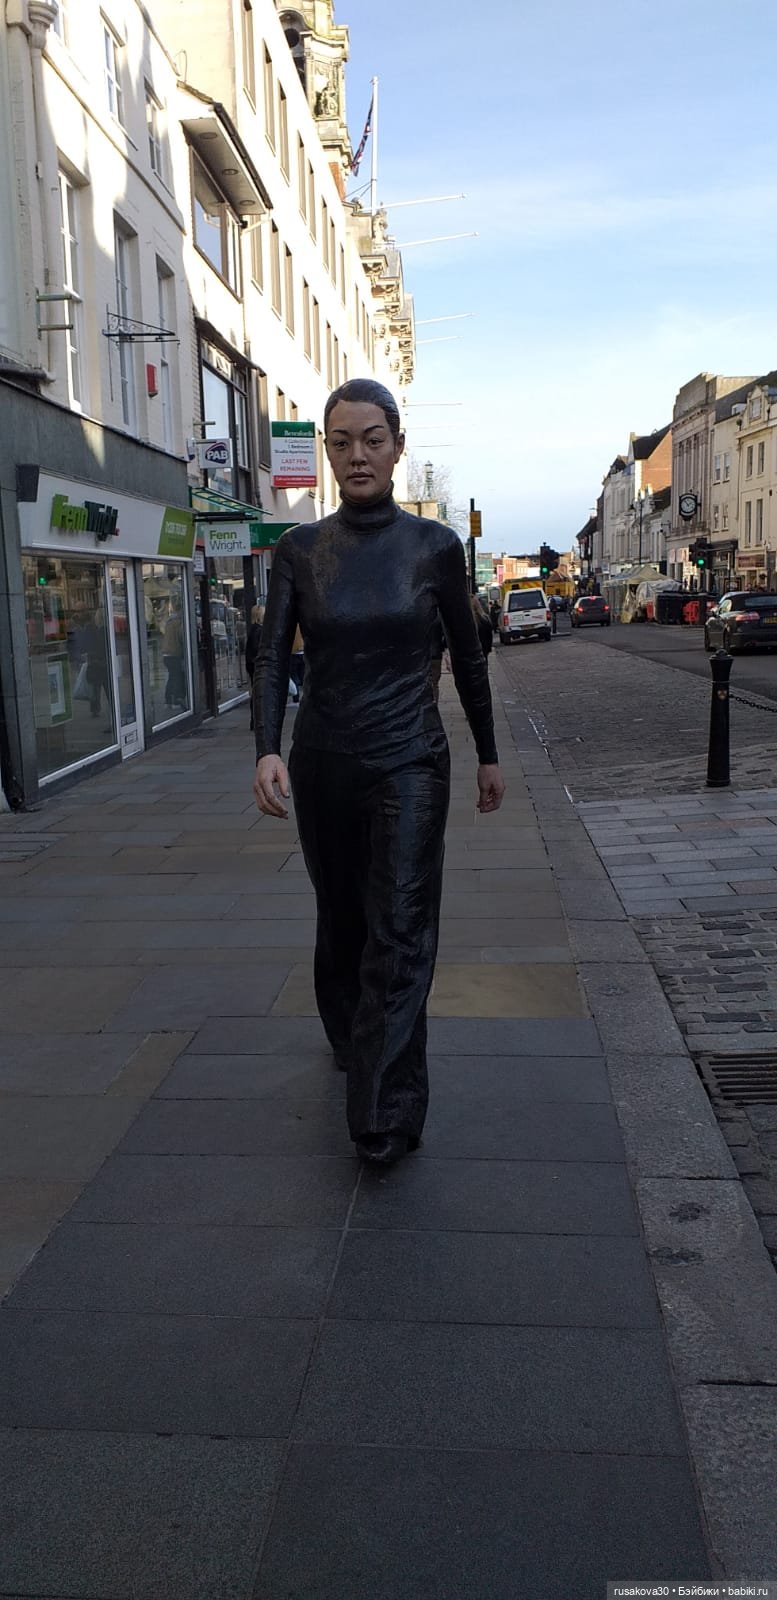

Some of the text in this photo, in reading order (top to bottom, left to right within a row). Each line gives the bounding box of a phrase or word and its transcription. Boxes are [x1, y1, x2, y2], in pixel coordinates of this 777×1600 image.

[206, 449, 228, 460] PAB
[209, 530, 237, 540] Fenn
[210, 541, 246, 552] Wright.
